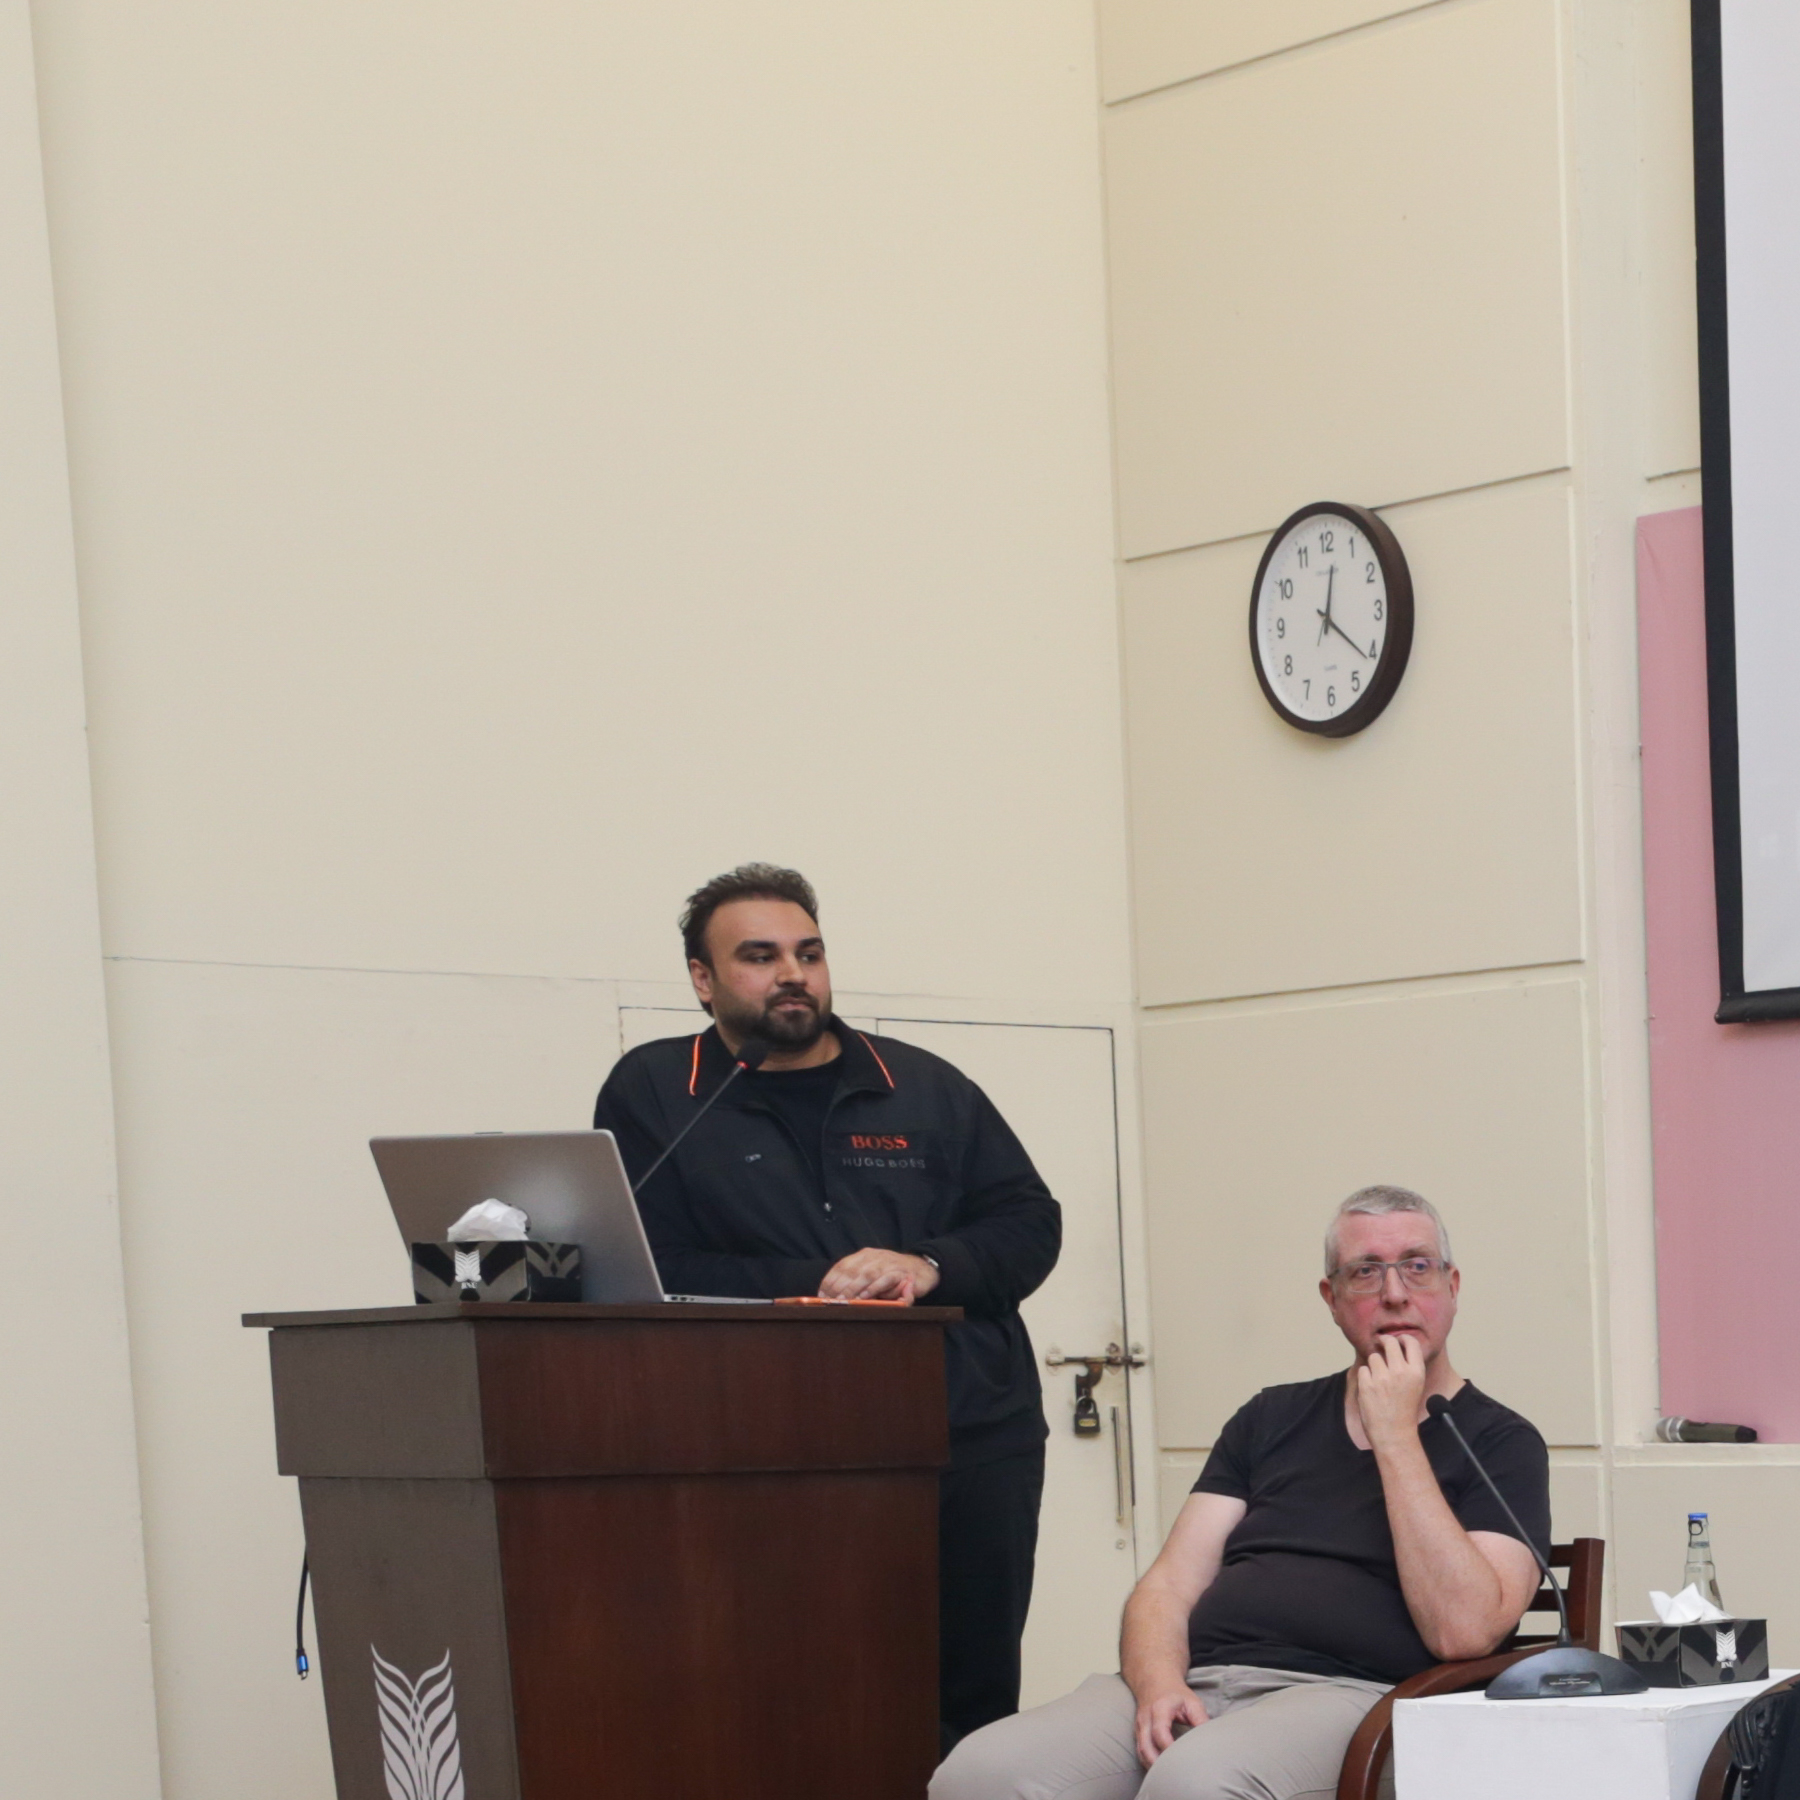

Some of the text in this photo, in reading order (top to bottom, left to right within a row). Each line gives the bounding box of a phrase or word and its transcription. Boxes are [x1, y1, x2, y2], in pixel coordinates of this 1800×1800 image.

[1319, 531, 1334, 553] 12
[1298, 546, 1309, 568] 11
[1366, 562, 1375, 584] 2
[1278, 579, 1293, 600] 10
[1374, 599, 1383, 621] 3
[1277, 618, 1285, 639] 9
[1369, 639, 1377, 660] 4
[1284, 655, 1293, 676] 8
[1303, 679, 1311, 700] 7
[1351, 671, 1360, 692] 5
[1327, 686, 1336, 707] 6
[851, 1135, 909, 1151] BOSS
[842, 1157, 886, 1168] HUGO
